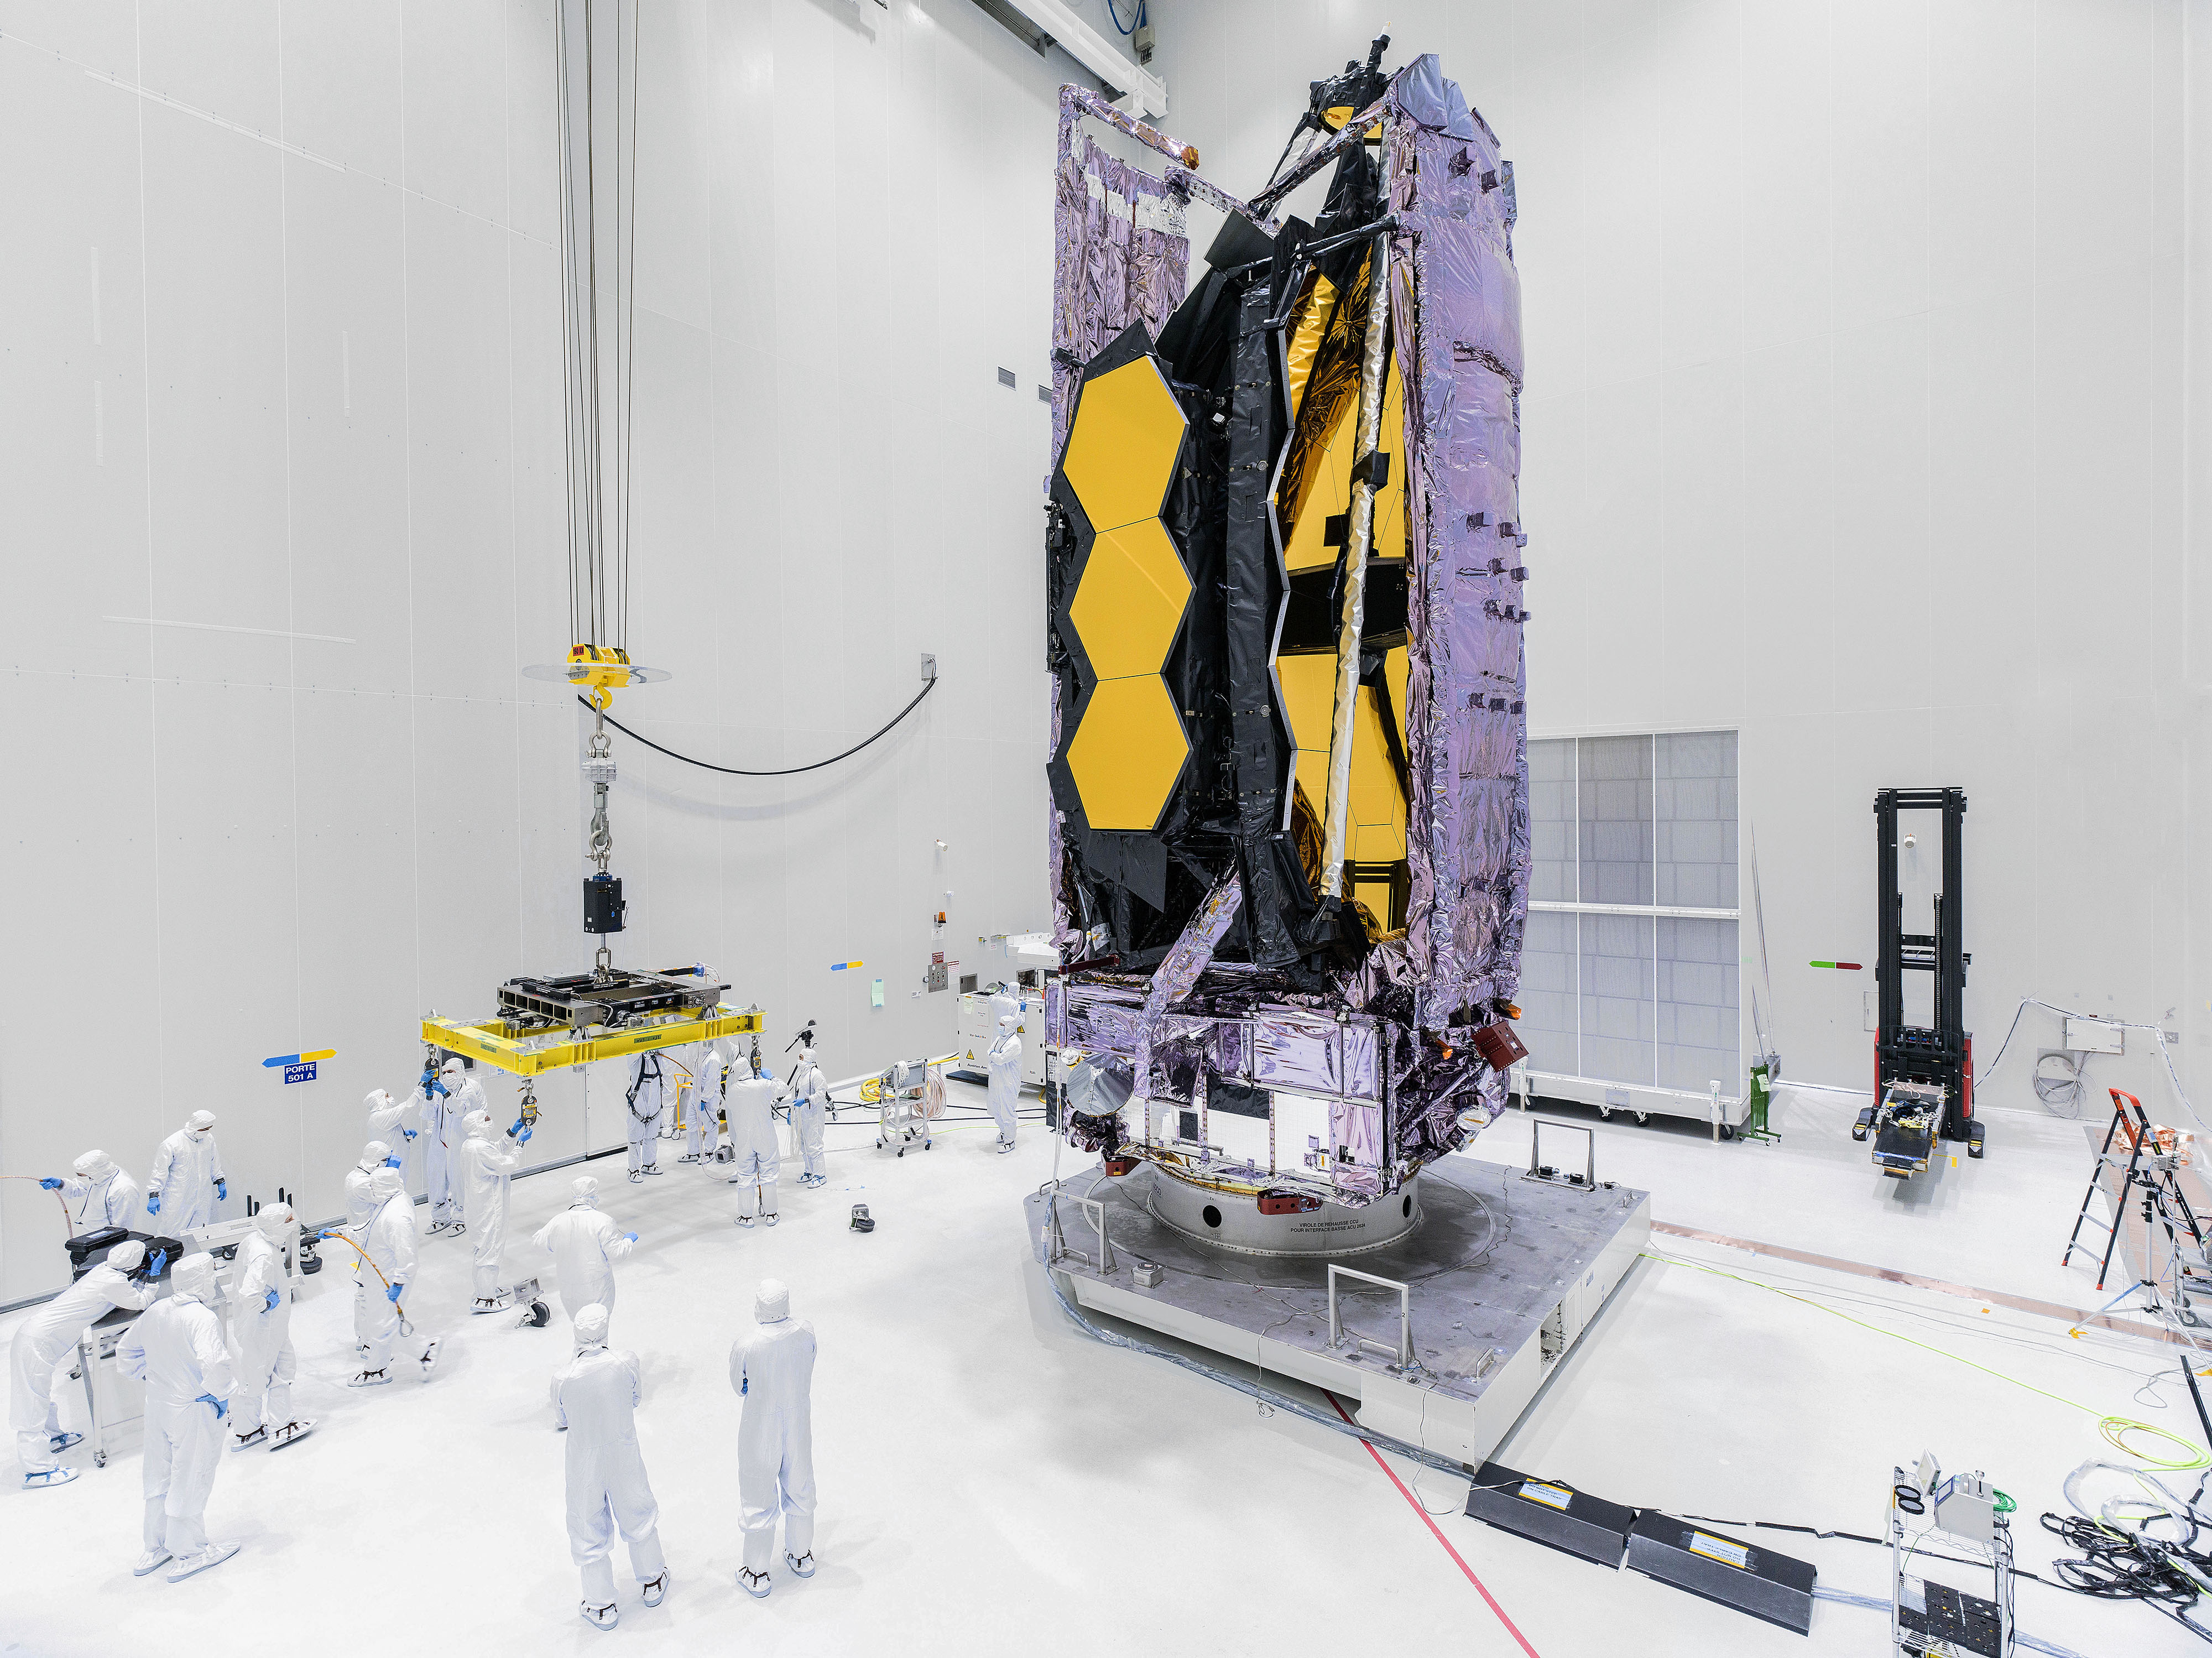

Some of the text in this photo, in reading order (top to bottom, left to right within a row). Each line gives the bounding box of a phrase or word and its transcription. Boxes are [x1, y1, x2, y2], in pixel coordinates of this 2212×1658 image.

[286, 1063, 315, 1074] PORTE
[288, 1073, 304, 1082] 501
[1717, 1553, 1740, 1563] CAUTION
